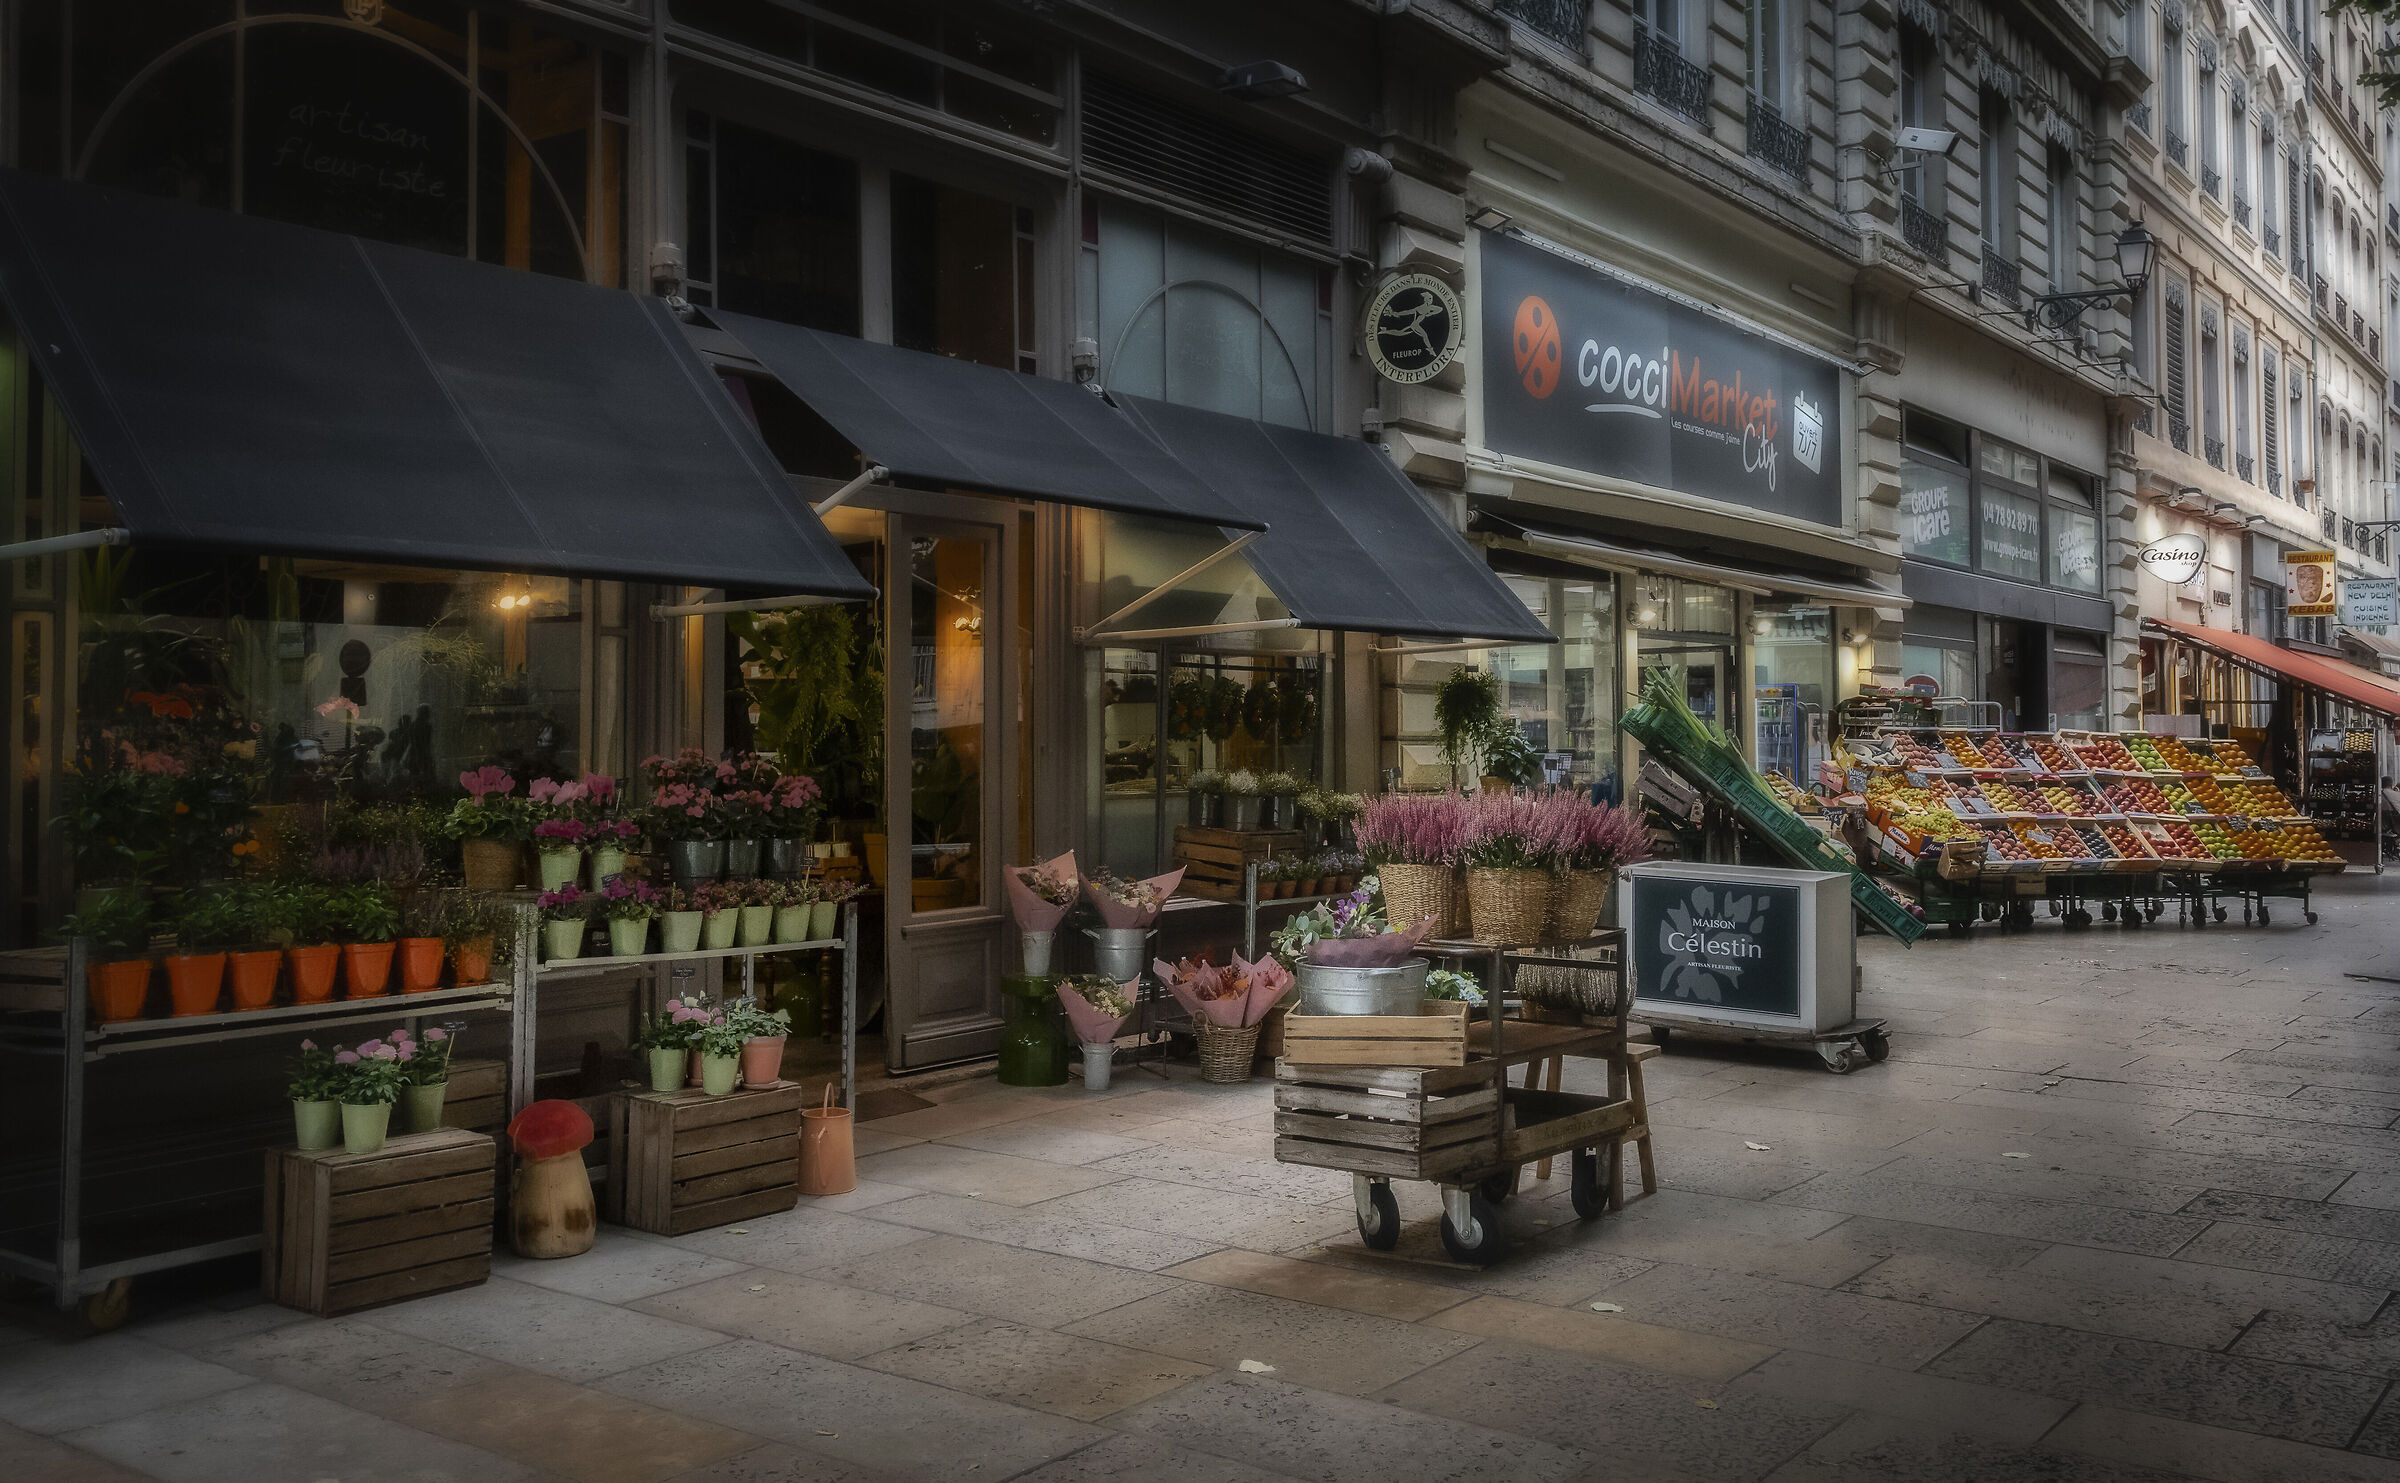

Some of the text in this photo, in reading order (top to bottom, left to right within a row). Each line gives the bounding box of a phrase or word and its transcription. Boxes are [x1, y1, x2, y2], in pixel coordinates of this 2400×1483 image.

[288, 99, 432, 153] artisan
[272, 136, 446, 197] fleuriste
[1371, 290, 1390, 322] FLEURS
[1390, 278, 1412, 293] DANS
[1424, 278, 1450, 299] MONDE
[1448, 297, 1459, 330] ENTIER
[1375, 345, 1455, 382] INTERFLORA
[1392, 348, 1422, 359] FLEUROP
[1671, 416, 1682, 430] Les
[1683, 422, 1704, 436] courses
[1705, 428, 1725, 441] comme
[1799, 421, 1818, 442] ouvert
[1743, 422, 1778, 493] City
[1911, 486, 1949, 515] GROUPE
[1983, 502, 2038, 536] 04 78 92 89 70
[2140, 548, 2199, 563] Casino
[2286, 553, 2334, 563] RESTAURANT
[2347, 582, 2394, 590] RESTAURANT
[2348, 592, 2394, 601] NEW DELHI
[2288, 604, 2334, 614] KEBAB
[2353, 614, 2389, 622] INDIENNE
[1692, 918, 1736, 930] MAISON
[1668, 932, 1762, 959] Célestin
[1687, 961, 1742, 971] ARTISAN FLEURISTE
